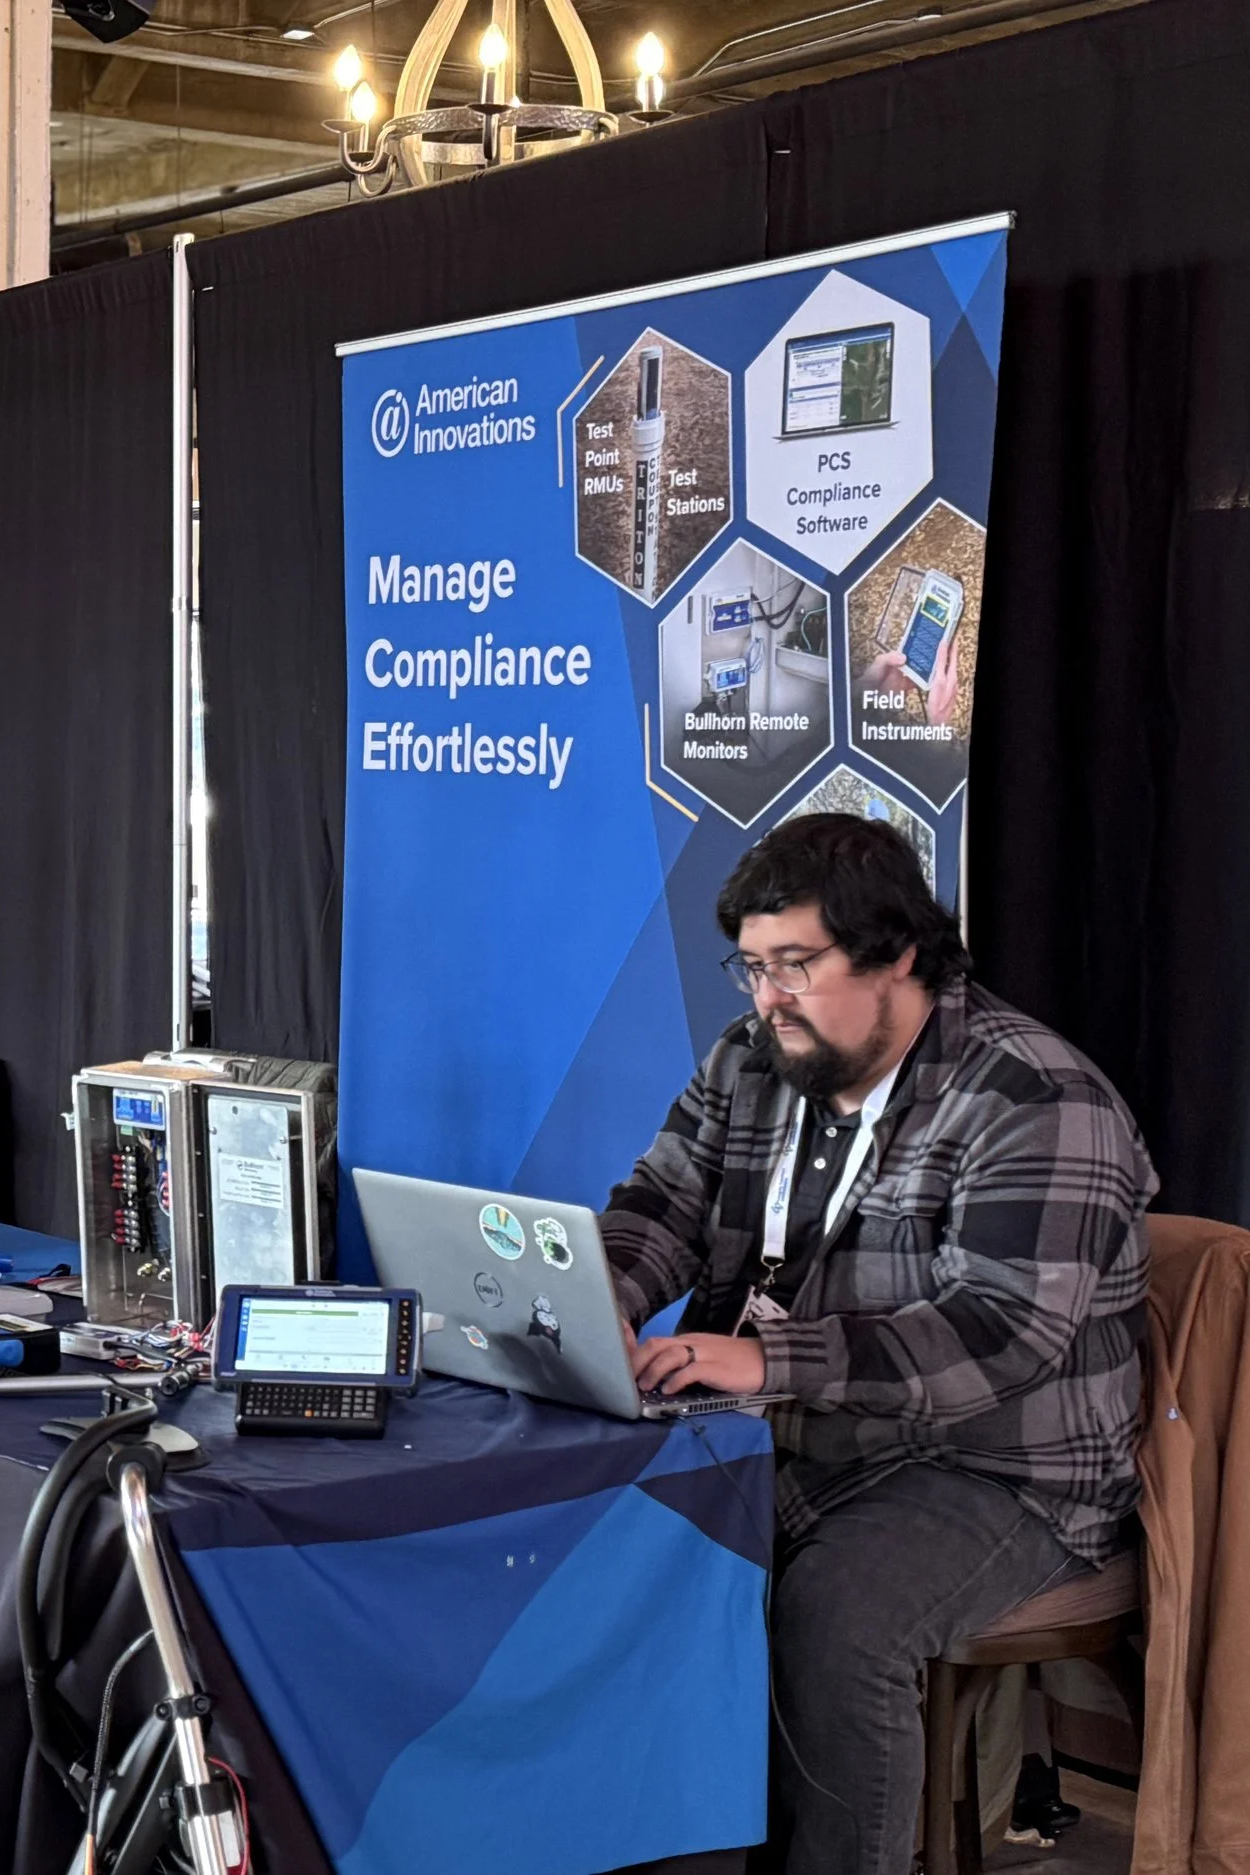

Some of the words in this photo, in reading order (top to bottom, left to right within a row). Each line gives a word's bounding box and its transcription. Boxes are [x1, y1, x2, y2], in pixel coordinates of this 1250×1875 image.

[415, 375, 518, 417] American
[413, 412, 536, 455] Innovations
[586, 422, 614, 440] Test
[585, 448, 620, 468] Point
[817, 452, 851, 472] PCS
[584, 475, 624, 495] RMUs
[668, 469, 698, 488] Test
[787, 479, 881, 509] Compliance
[666, 495, 725, 516] Stations
[796, 512, 868, 535] Software
[368, 556, 516, 612] Manage
[365, 636, 591, 699] Compliance
[863, 691, 905, 710] Field
[685, 712, 746, 731] Bullhorn
[749, 713, 809, 731] Remote
[862, 721, 952, 741] Instruments
[362, 722, 574, 790] Effortlessly
[684, 741, 748, 759] Monitors
